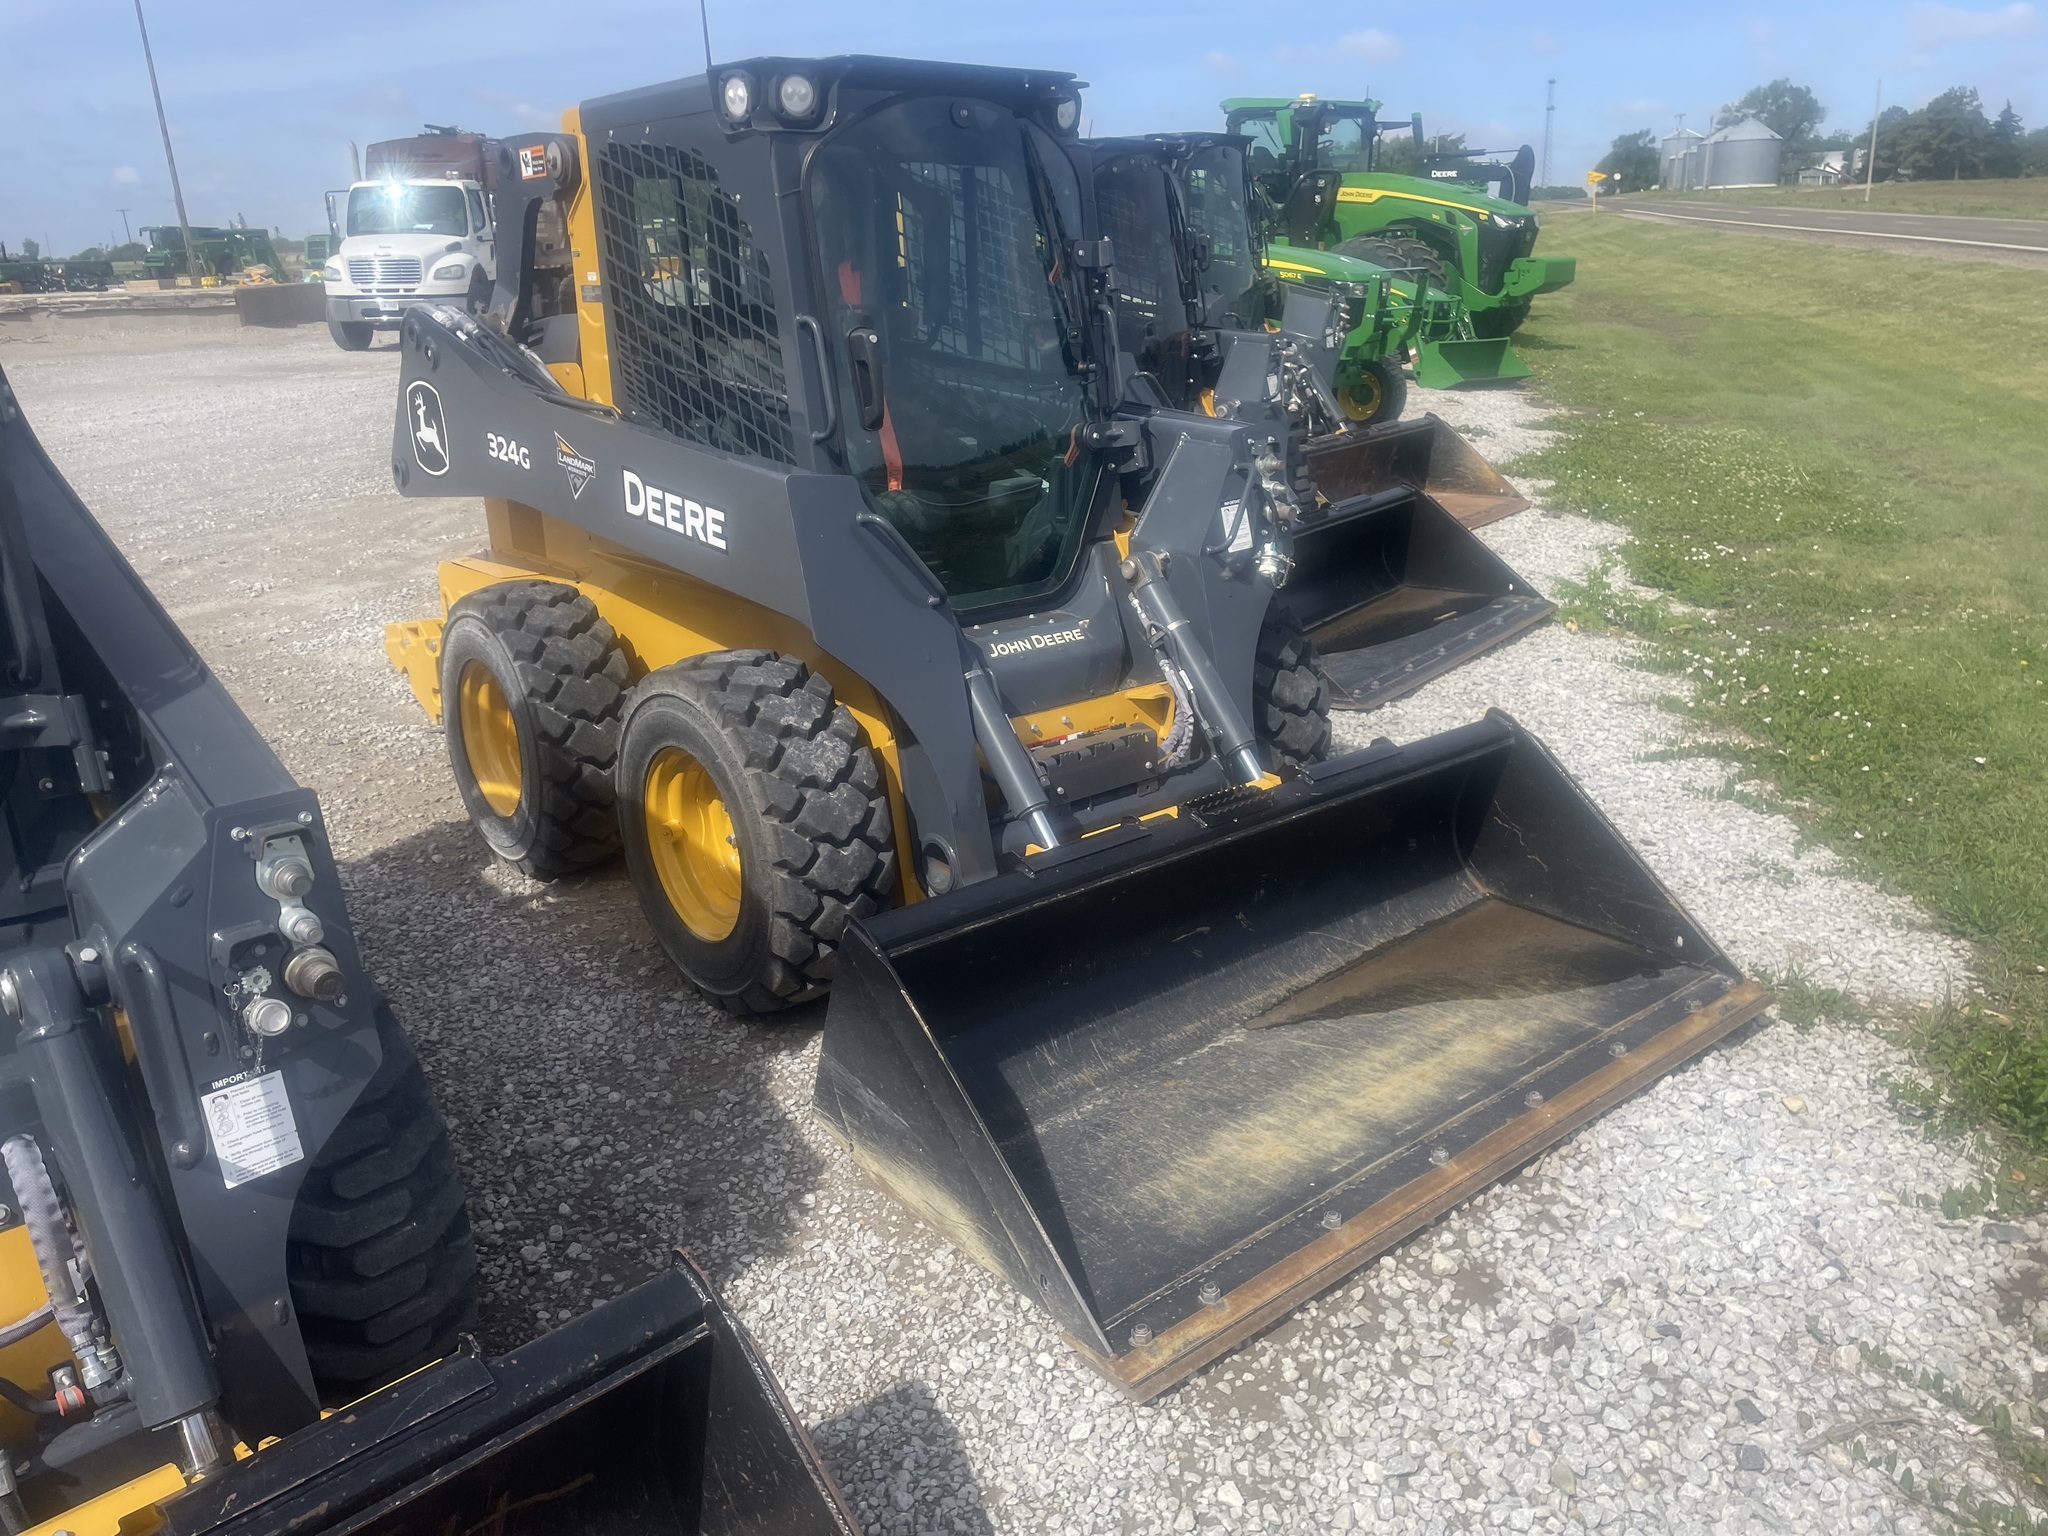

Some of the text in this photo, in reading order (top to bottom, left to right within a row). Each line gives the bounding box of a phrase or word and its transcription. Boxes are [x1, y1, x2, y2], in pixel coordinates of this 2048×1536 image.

[1431, 170, 1458, 178] DEERE
[487, 432, 531, 470] 324G
[622, 469, 727, 550] DEERE
[990, 629, 1085, 658] JOHN DEERE
[212, 1065, 266, 1090] IMPORTT
